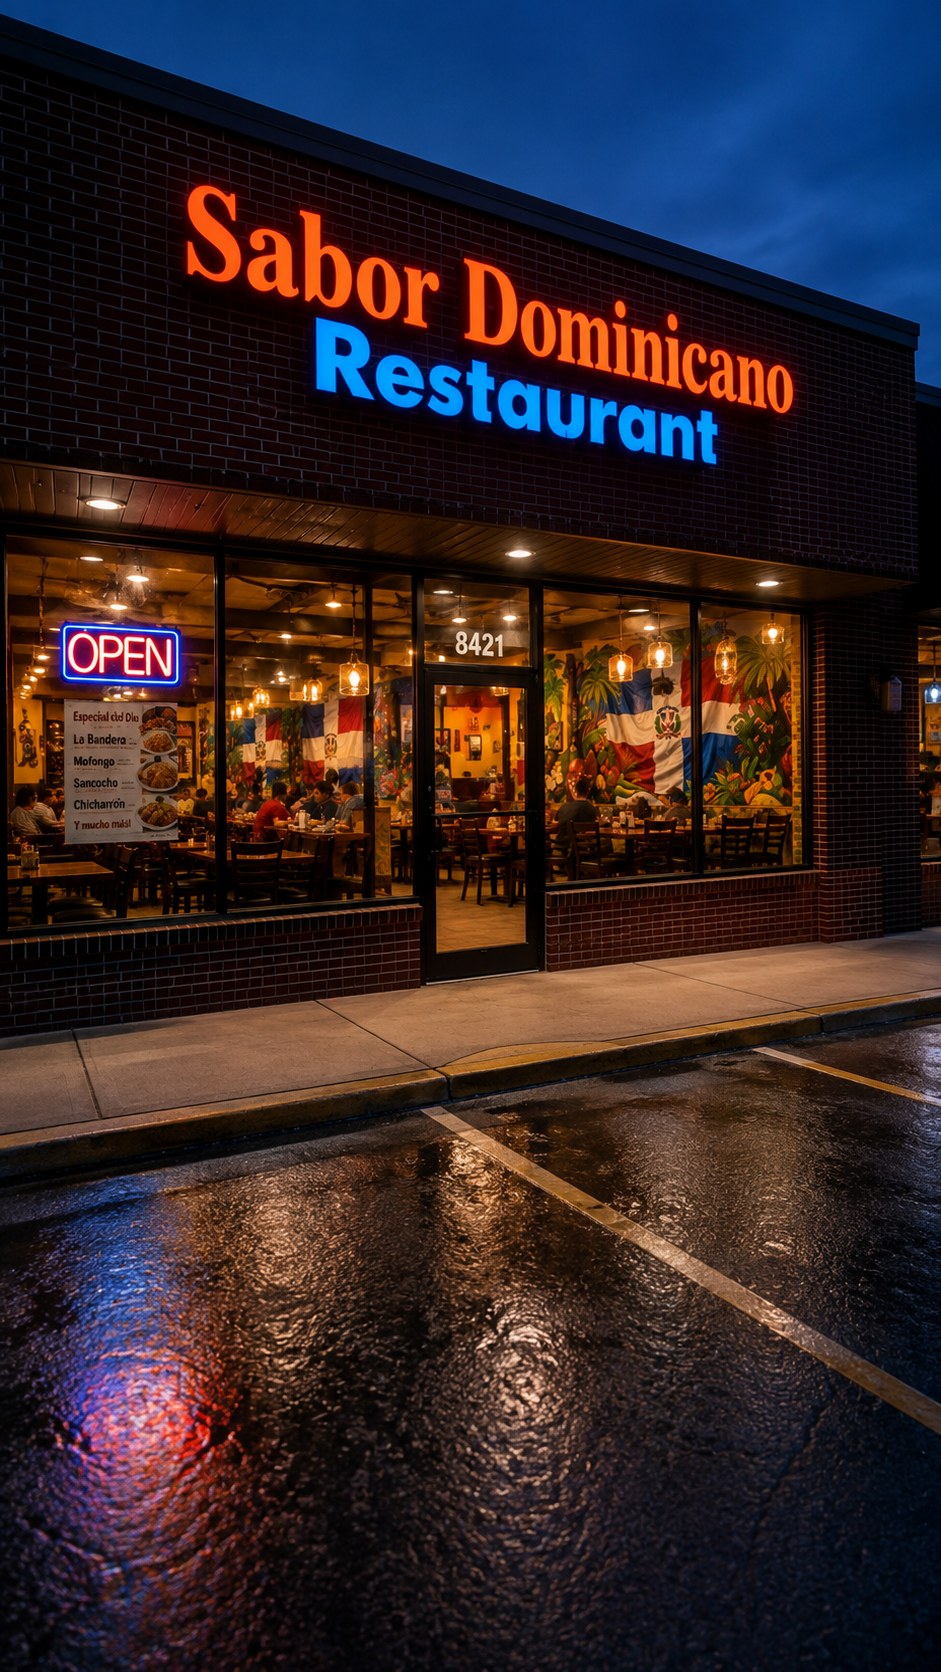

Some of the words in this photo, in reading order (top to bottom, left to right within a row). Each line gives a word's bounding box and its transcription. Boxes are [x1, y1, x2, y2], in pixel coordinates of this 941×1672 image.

[187, 185, 440, 329] Sabor
[463, 257, 794, 414] Dominicano
[315, 317, 718, 465] Restaurant
[455, 630, 503, 657] 8421
[67, 633, 172, 677] OPEN
[73, 711, 109, 725] Especial
[73, 734, 85, 745] La
[87, 733, 127, 745] Bandera
[73, 756, 115, 769] Mofongo
[73, 777, 118, 788] Sancocho
[74, 820, 80, 830] Y
[81, 819, 110, 830] mucho
